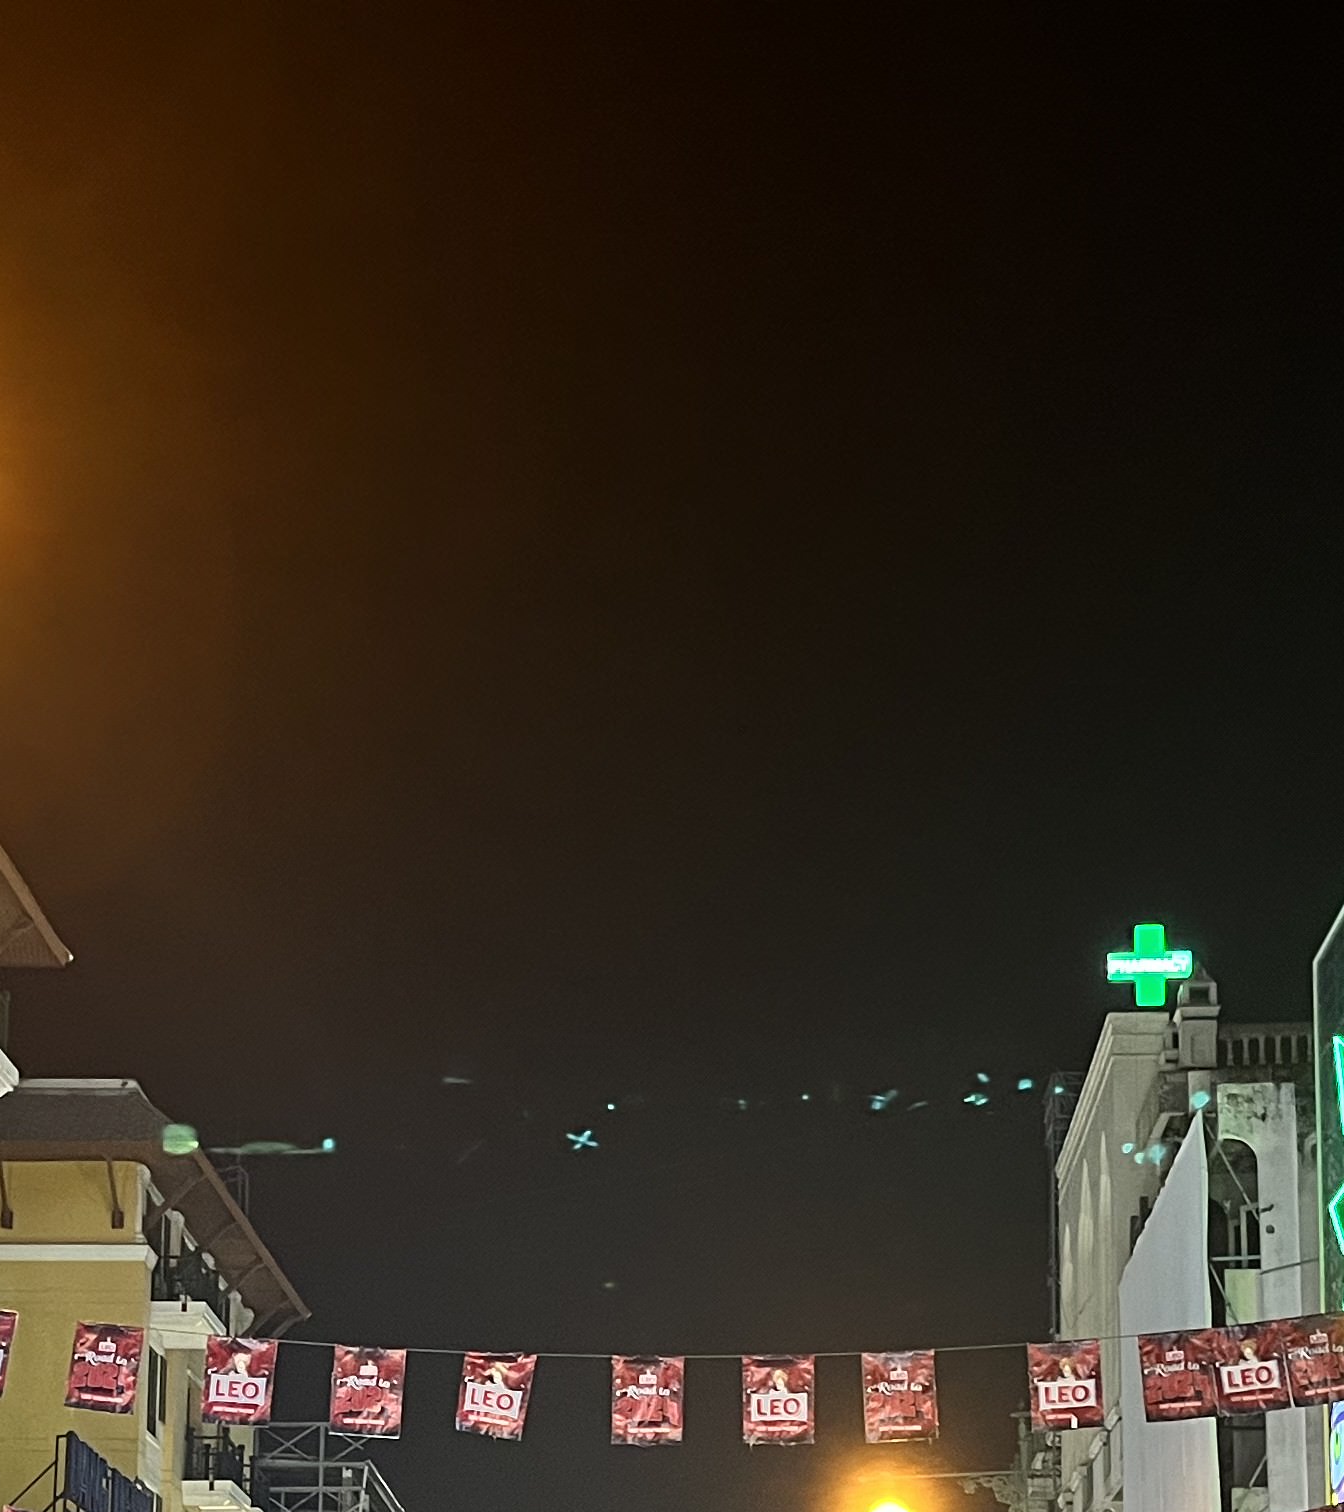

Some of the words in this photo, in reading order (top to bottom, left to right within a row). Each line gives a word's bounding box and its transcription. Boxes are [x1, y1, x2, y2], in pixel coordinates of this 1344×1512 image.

[84, 1350, 115, 1366] Road
[1298, 1343, 1329, 1360] Road
[1155, 1361, 1185, 1377] Road
[1225, 1365, 1273, 1389] LEO
[214, 1380, 261, 1399] LEO
[345, 1375, 378, 1390] Road
[877, 1380, 909, 1395] Road
[470, 1389, 515, 1411] LEO
[625, 1385, 657, 1399] Road
[1043, 1385, 1089, 1404] LEO
[756, 1397, 801, 1417] LEO
